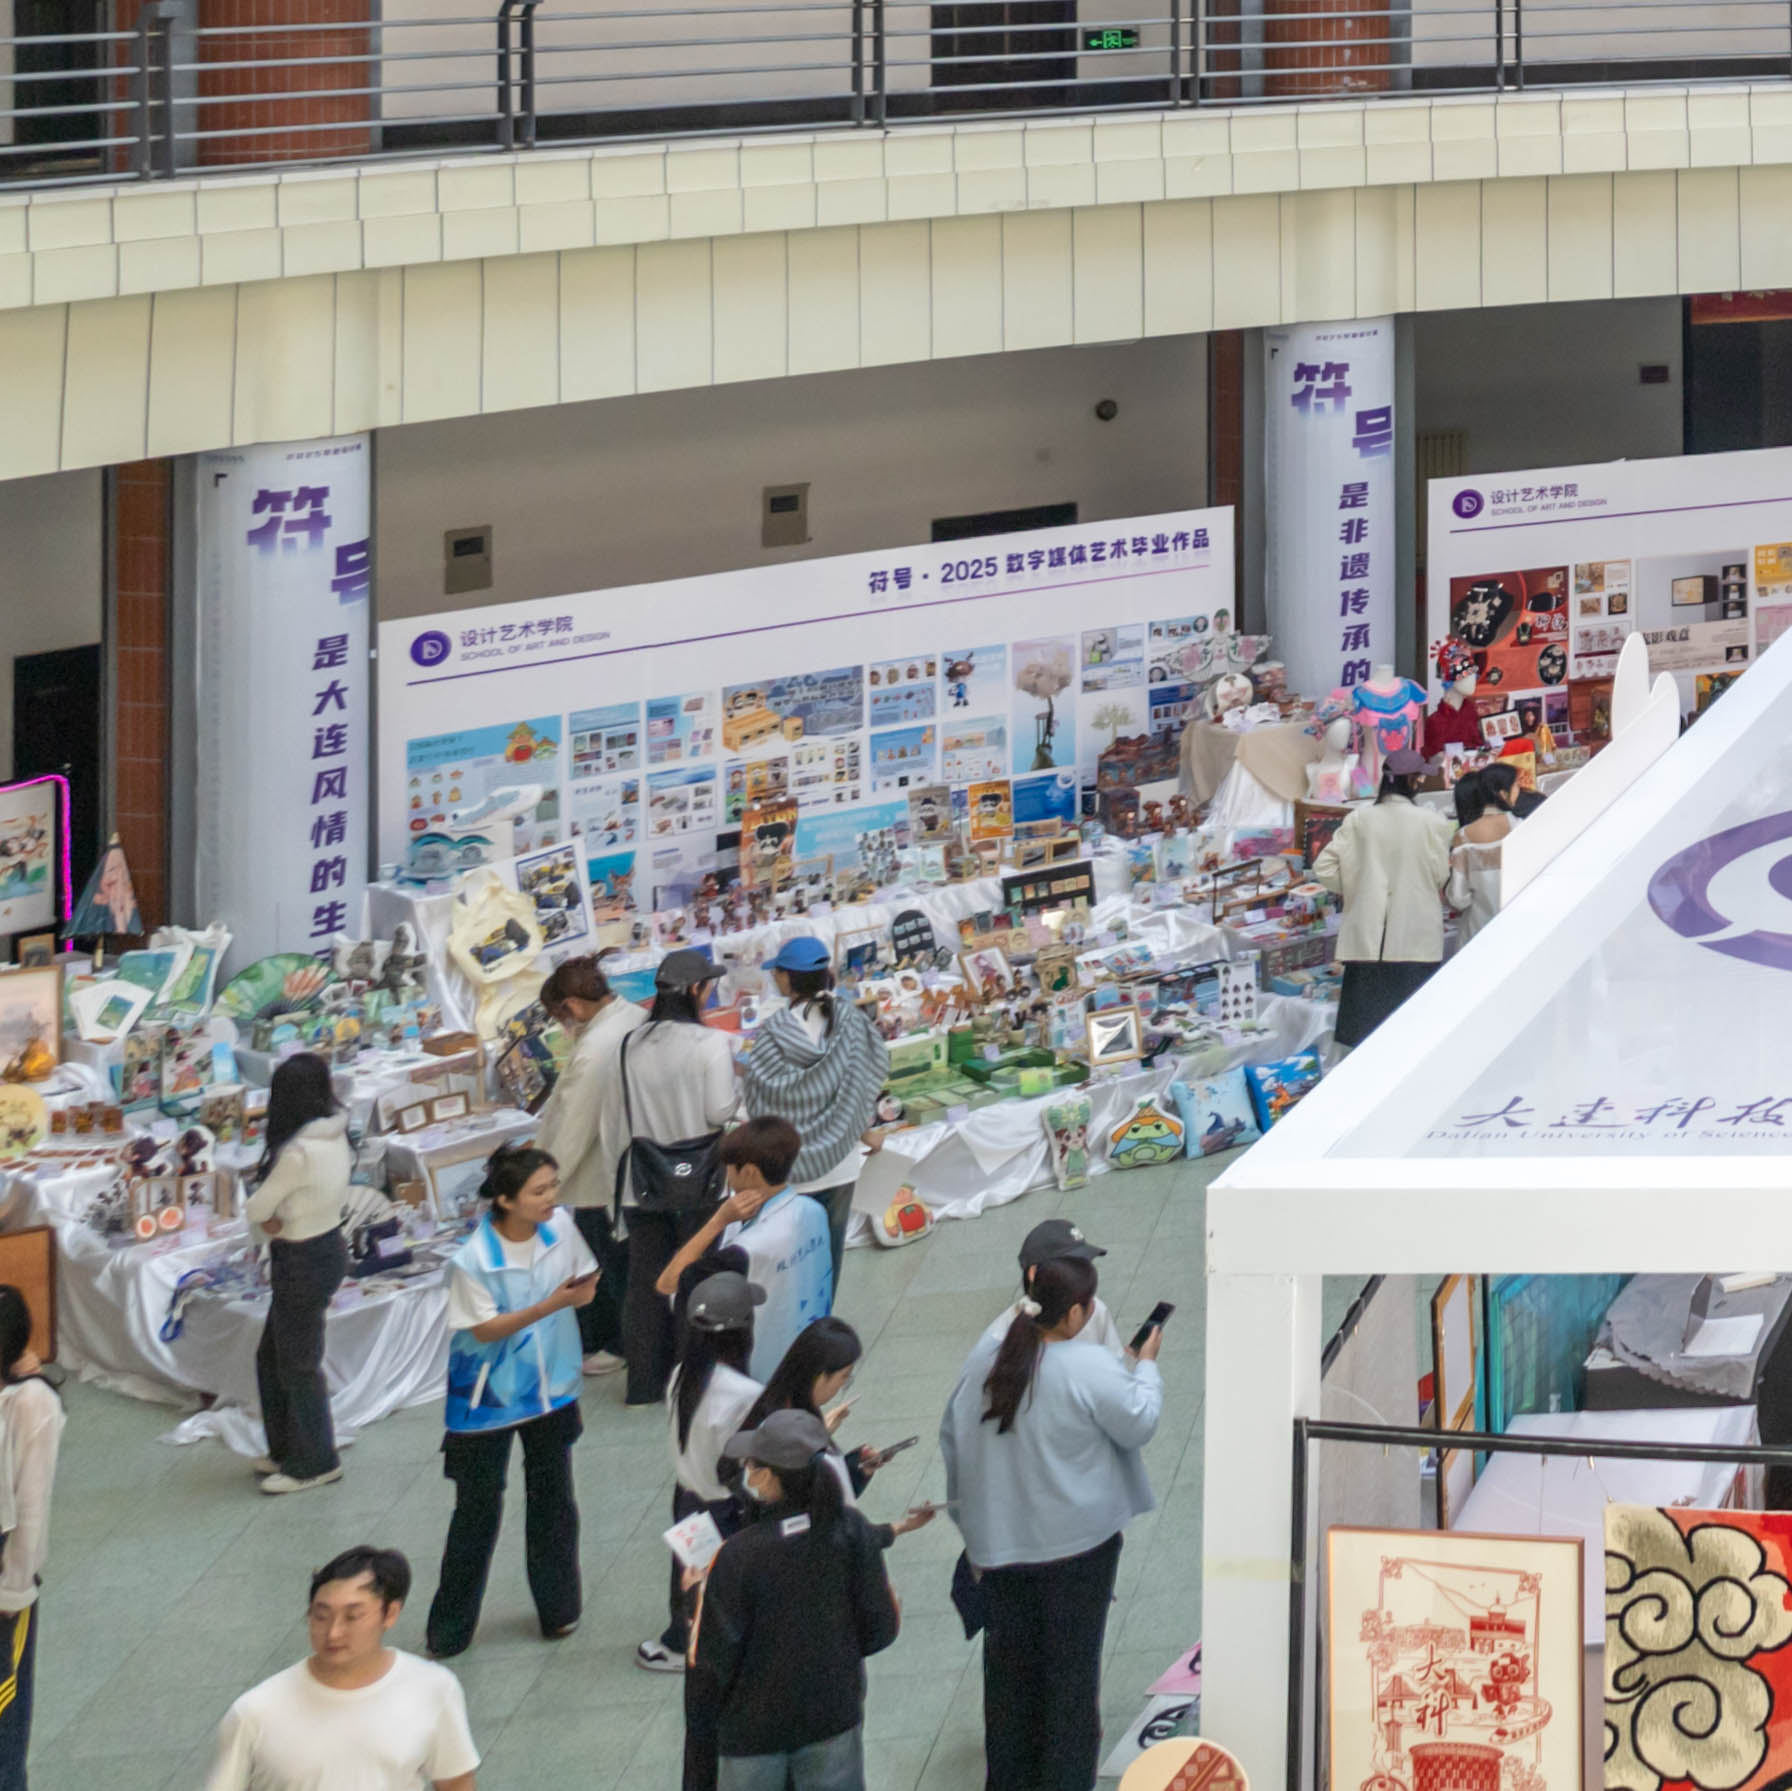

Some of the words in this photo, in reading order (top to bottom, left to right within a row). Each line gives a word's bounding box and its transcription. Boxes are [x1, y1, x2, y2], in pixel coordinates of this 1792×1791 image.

[1491, 483, 1579, 505] 设计艺术学院
[461, 616, 573, 647] 设计艺术学院
